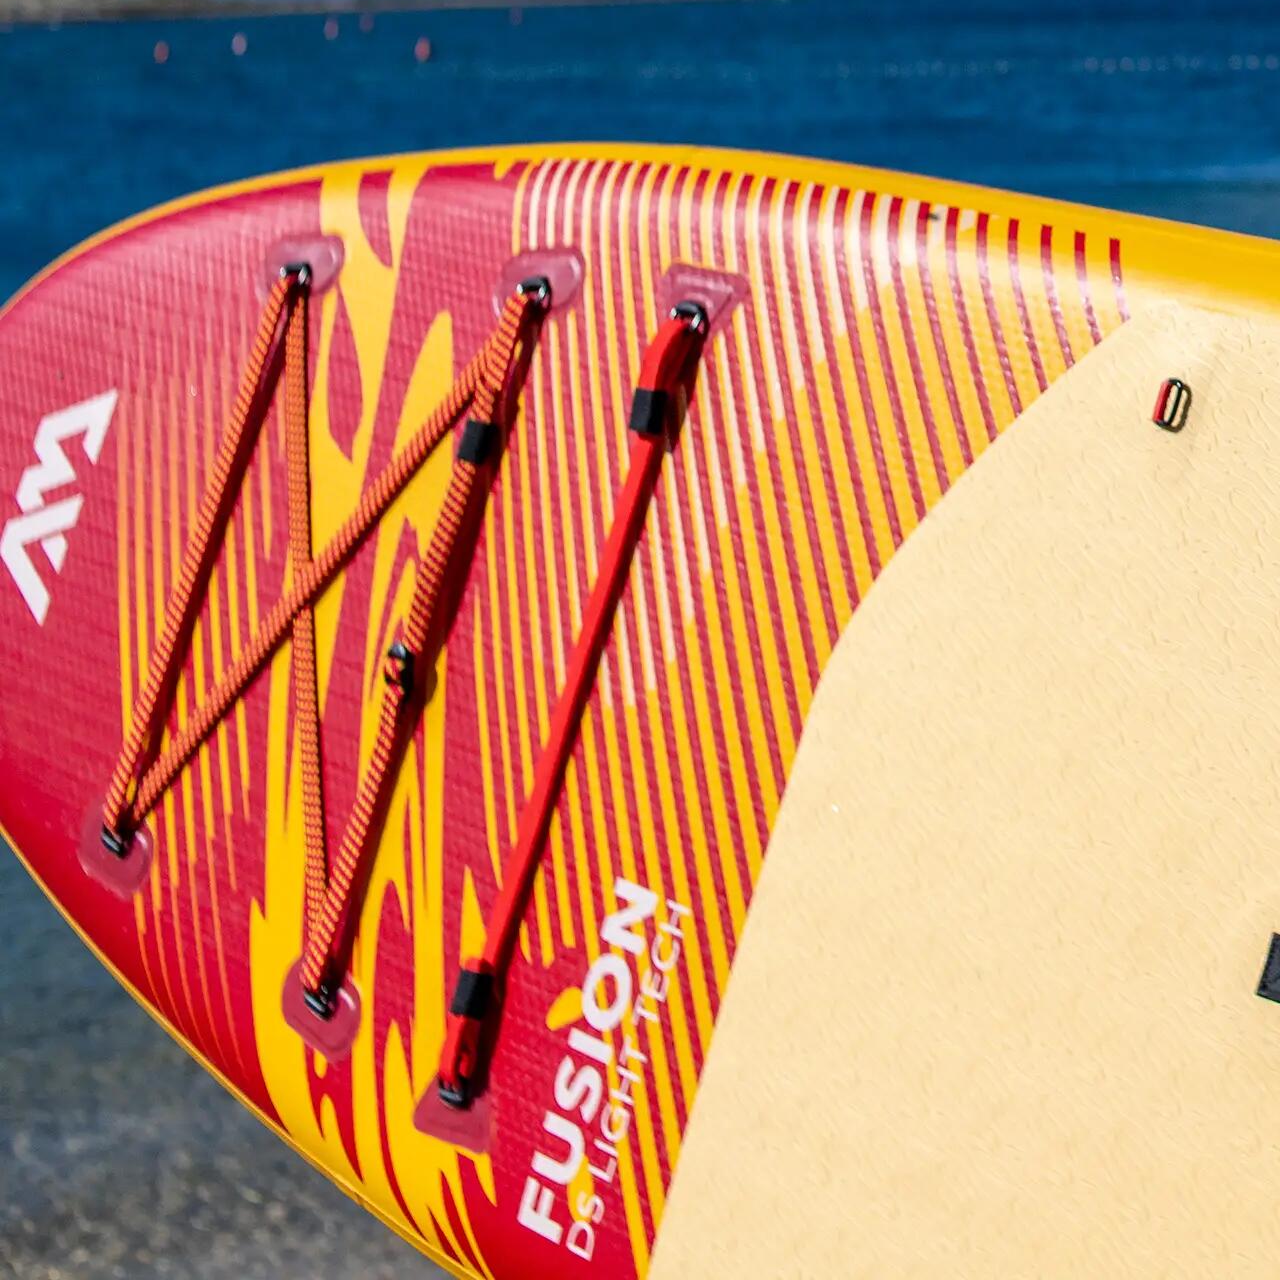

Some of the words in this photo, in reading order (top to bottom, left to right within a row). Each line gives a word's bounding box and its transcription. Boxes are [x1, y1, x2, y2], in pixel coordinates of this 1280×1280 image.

[517, 876, 659, 1245] FUSION
[566, 1189, 606, 1261] DS
[588, 1035, 648, 1184] LIGHT
[632, 898, 691, 1024] TECH
